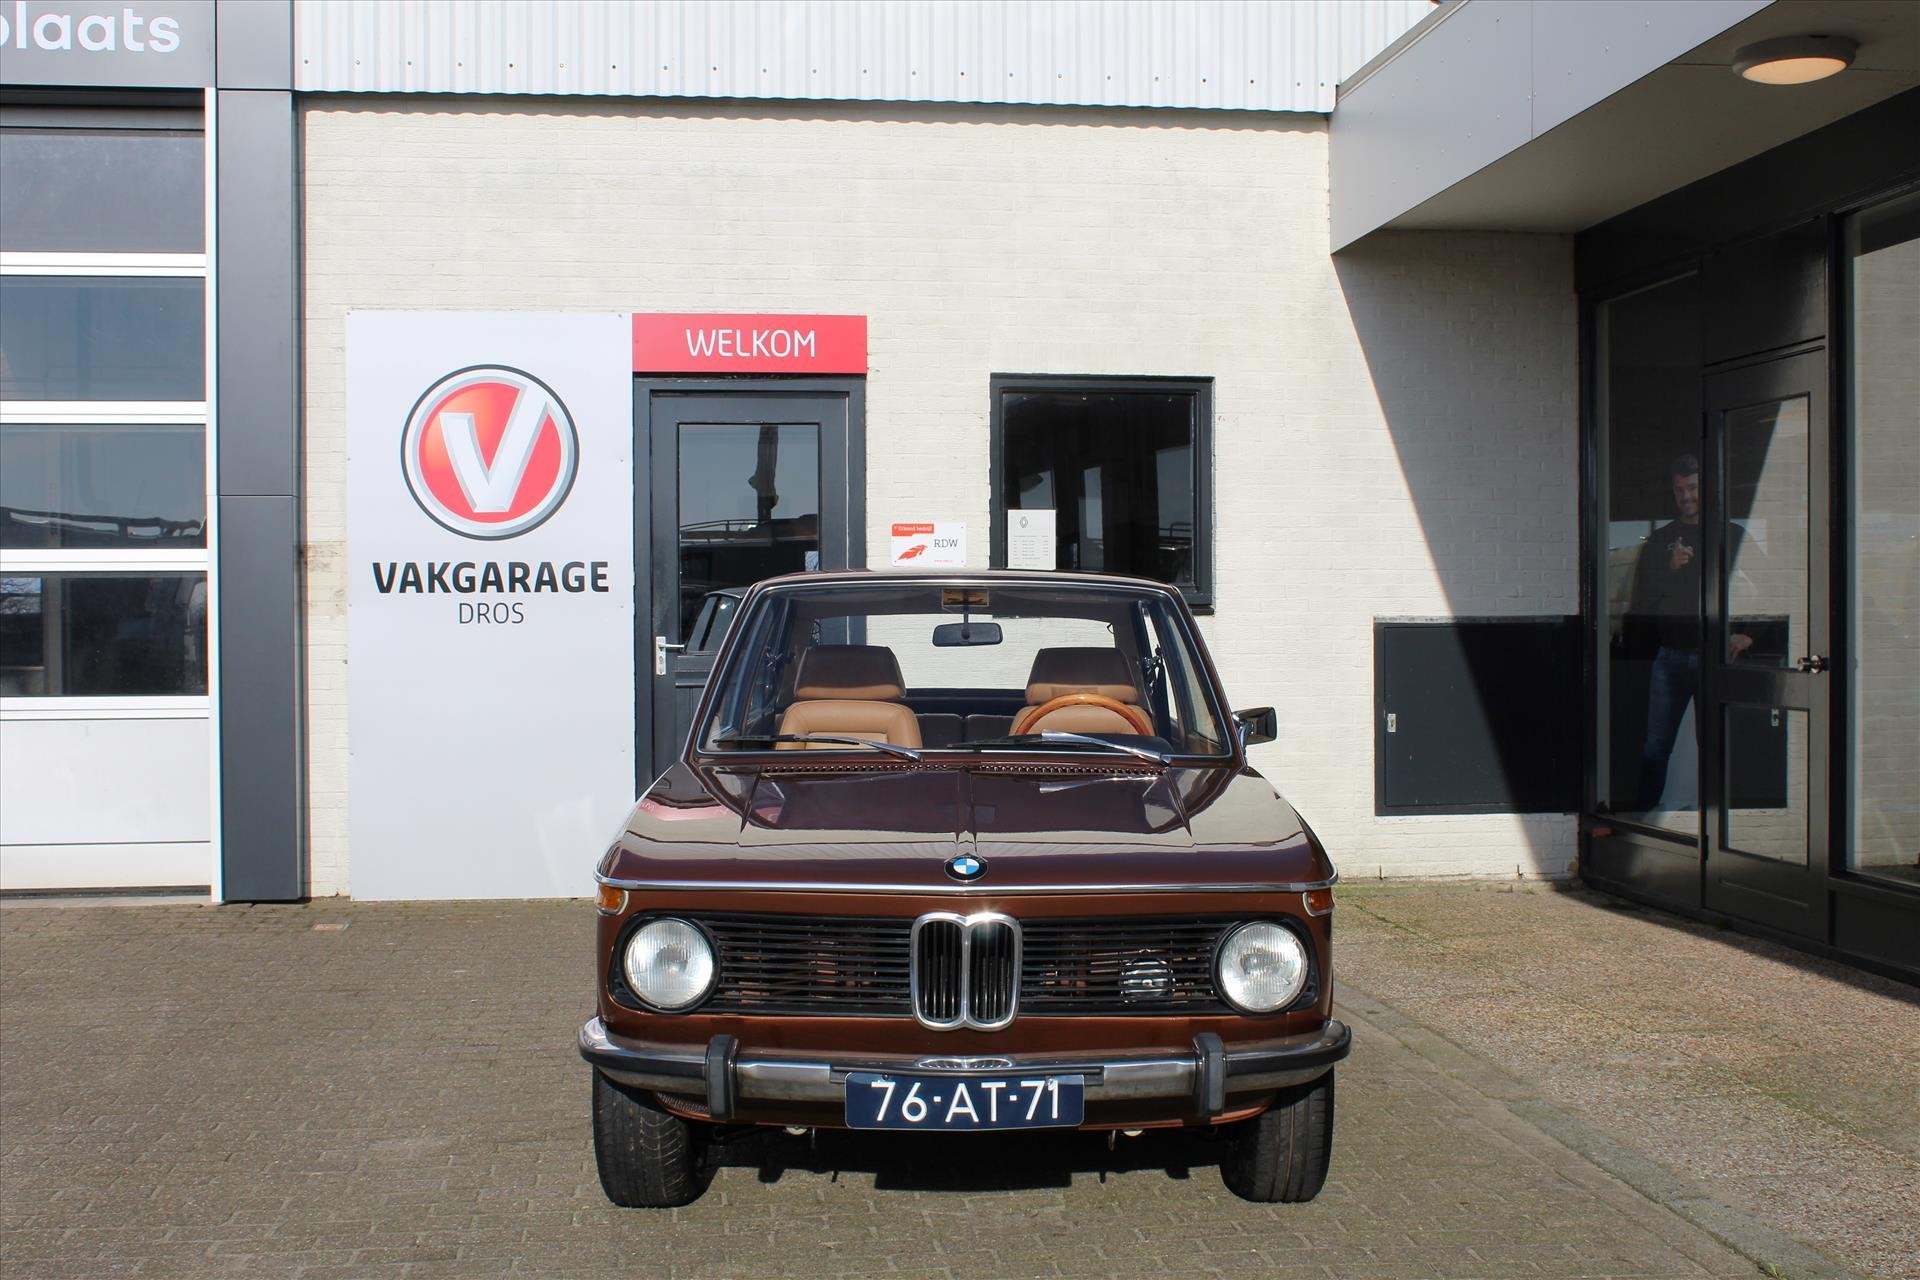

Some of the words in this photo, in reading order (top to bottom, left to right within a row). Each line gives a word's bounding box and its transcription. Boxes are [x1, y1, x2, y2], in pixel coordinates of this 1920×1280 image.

[0, 0, 180, 53] laats
[686, 329, 815, 357] WELKOM
[438, 383, 550, 513] V
[934, 538, 959, 548] RDW
[372, 561, 609, 593] VAKGARAGE
[458, 602, 525, 624] DROS
[870, 1079, 1059, 1123] 76-AT-71
